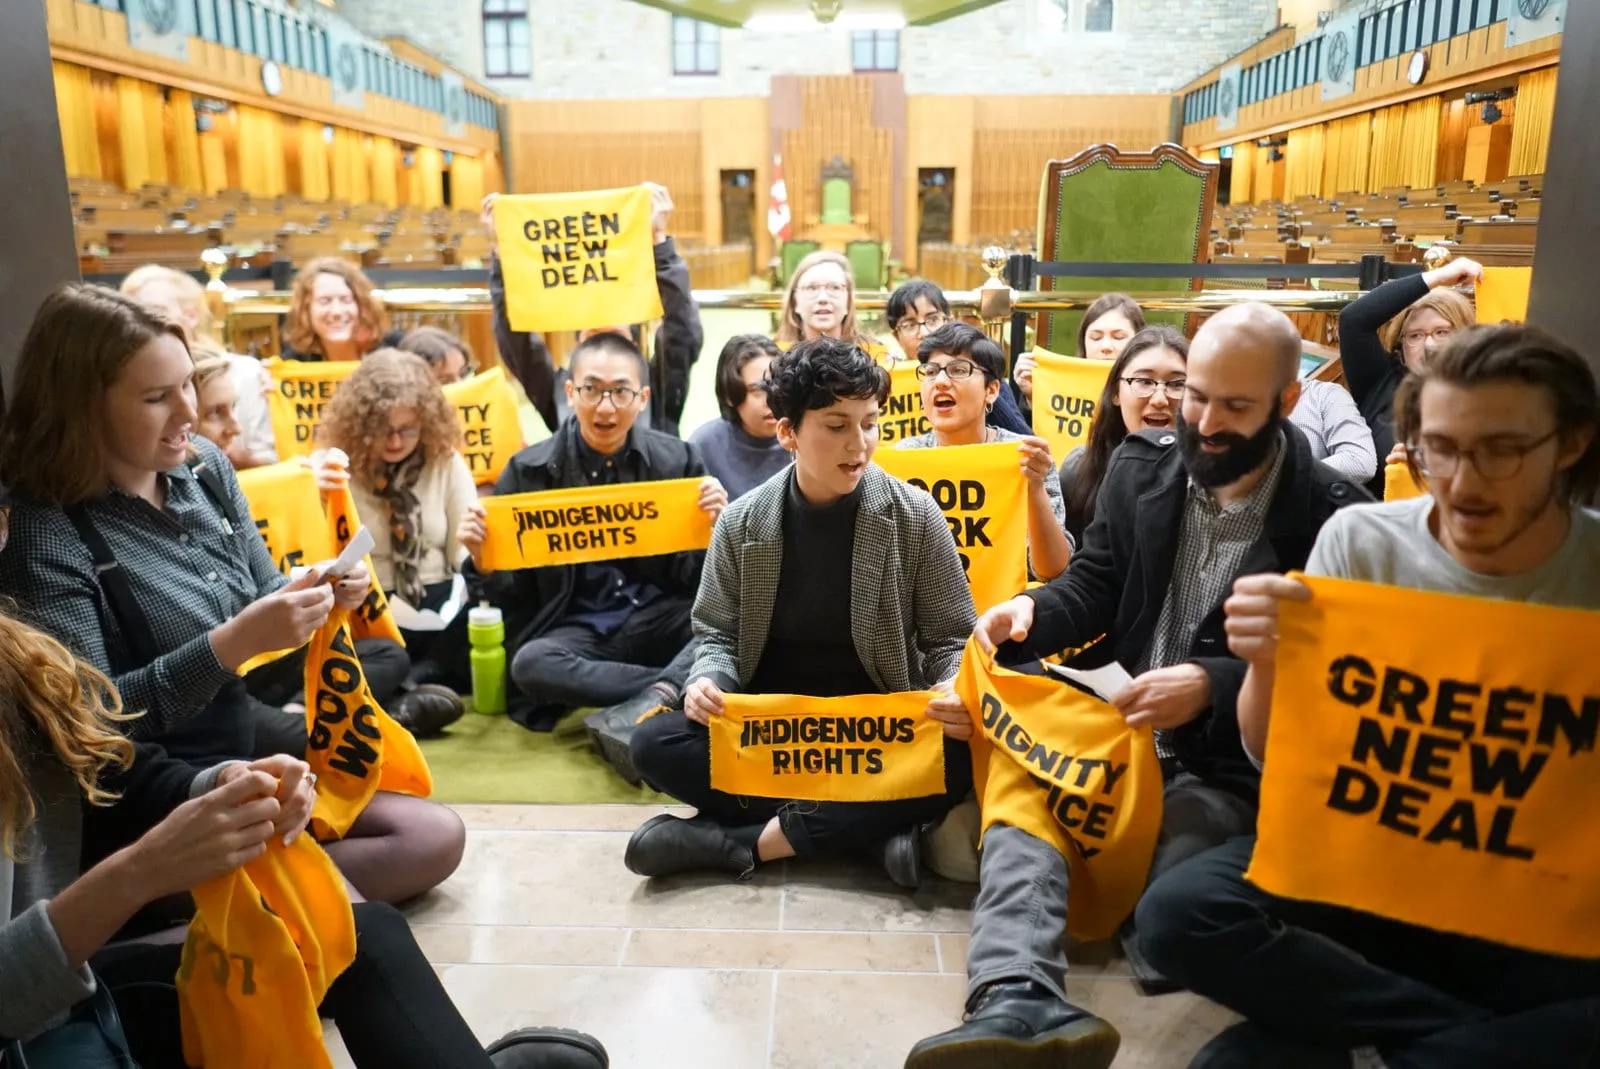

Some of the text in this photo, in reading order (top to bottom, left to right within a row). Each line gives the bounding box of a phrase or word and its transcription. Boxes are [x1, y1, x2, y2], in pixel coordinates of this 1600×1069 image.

[523, 211, 620, 241] GREEN
[541, 239, 608, 264] NEW
[541, 261, 619, 289] DEAL
[280, 379, 341, 399] GRE
[1051, 394, 1096, 418] OUR
[878, 416, 933, 441] STIC
[1055, 415, 1083, 437] TO
[514, 501, 659, 532] INDIGENOUS
[547, 526, 637, 553] RIGHTS
[1326, 654, 1600, 758] GREEN
[740, 715, 916, 748] INDIGENOUS
[981, 692, 1128, 795] DIGNITY
[772, 748, 884, 775] RIGHTS
[1351, 716, 1549, 801] NEW
[1326, 764, 1536, 862] DEAL
